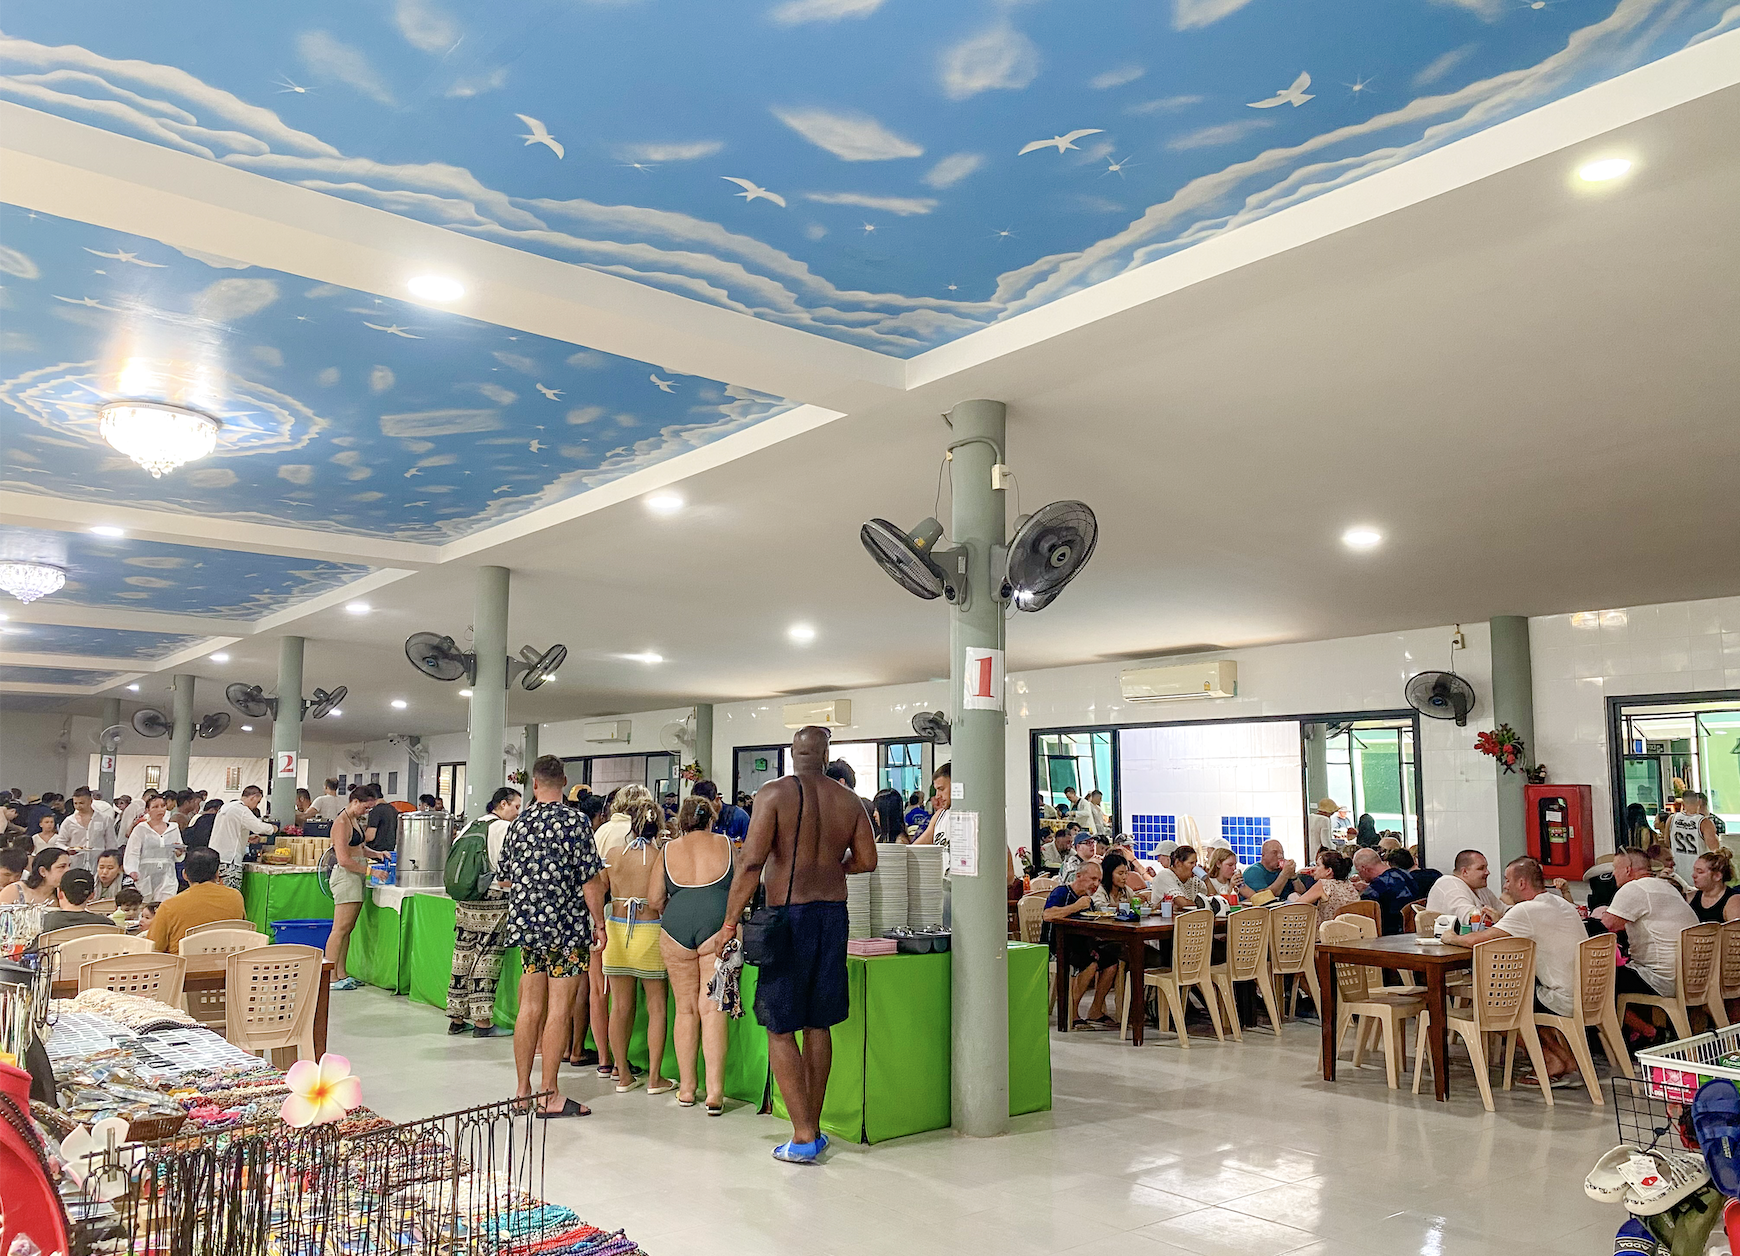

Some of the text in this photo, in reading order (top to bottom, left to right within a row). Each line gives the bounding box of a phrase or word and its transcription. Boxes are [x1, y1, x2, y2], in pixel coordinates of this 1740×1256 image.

[972, 656, 995, 698] 1
[102, 757, 112, 769] 3
[279, 754, 294, 773] 2
[1619, 1242, 1649, 1250] ADDA
